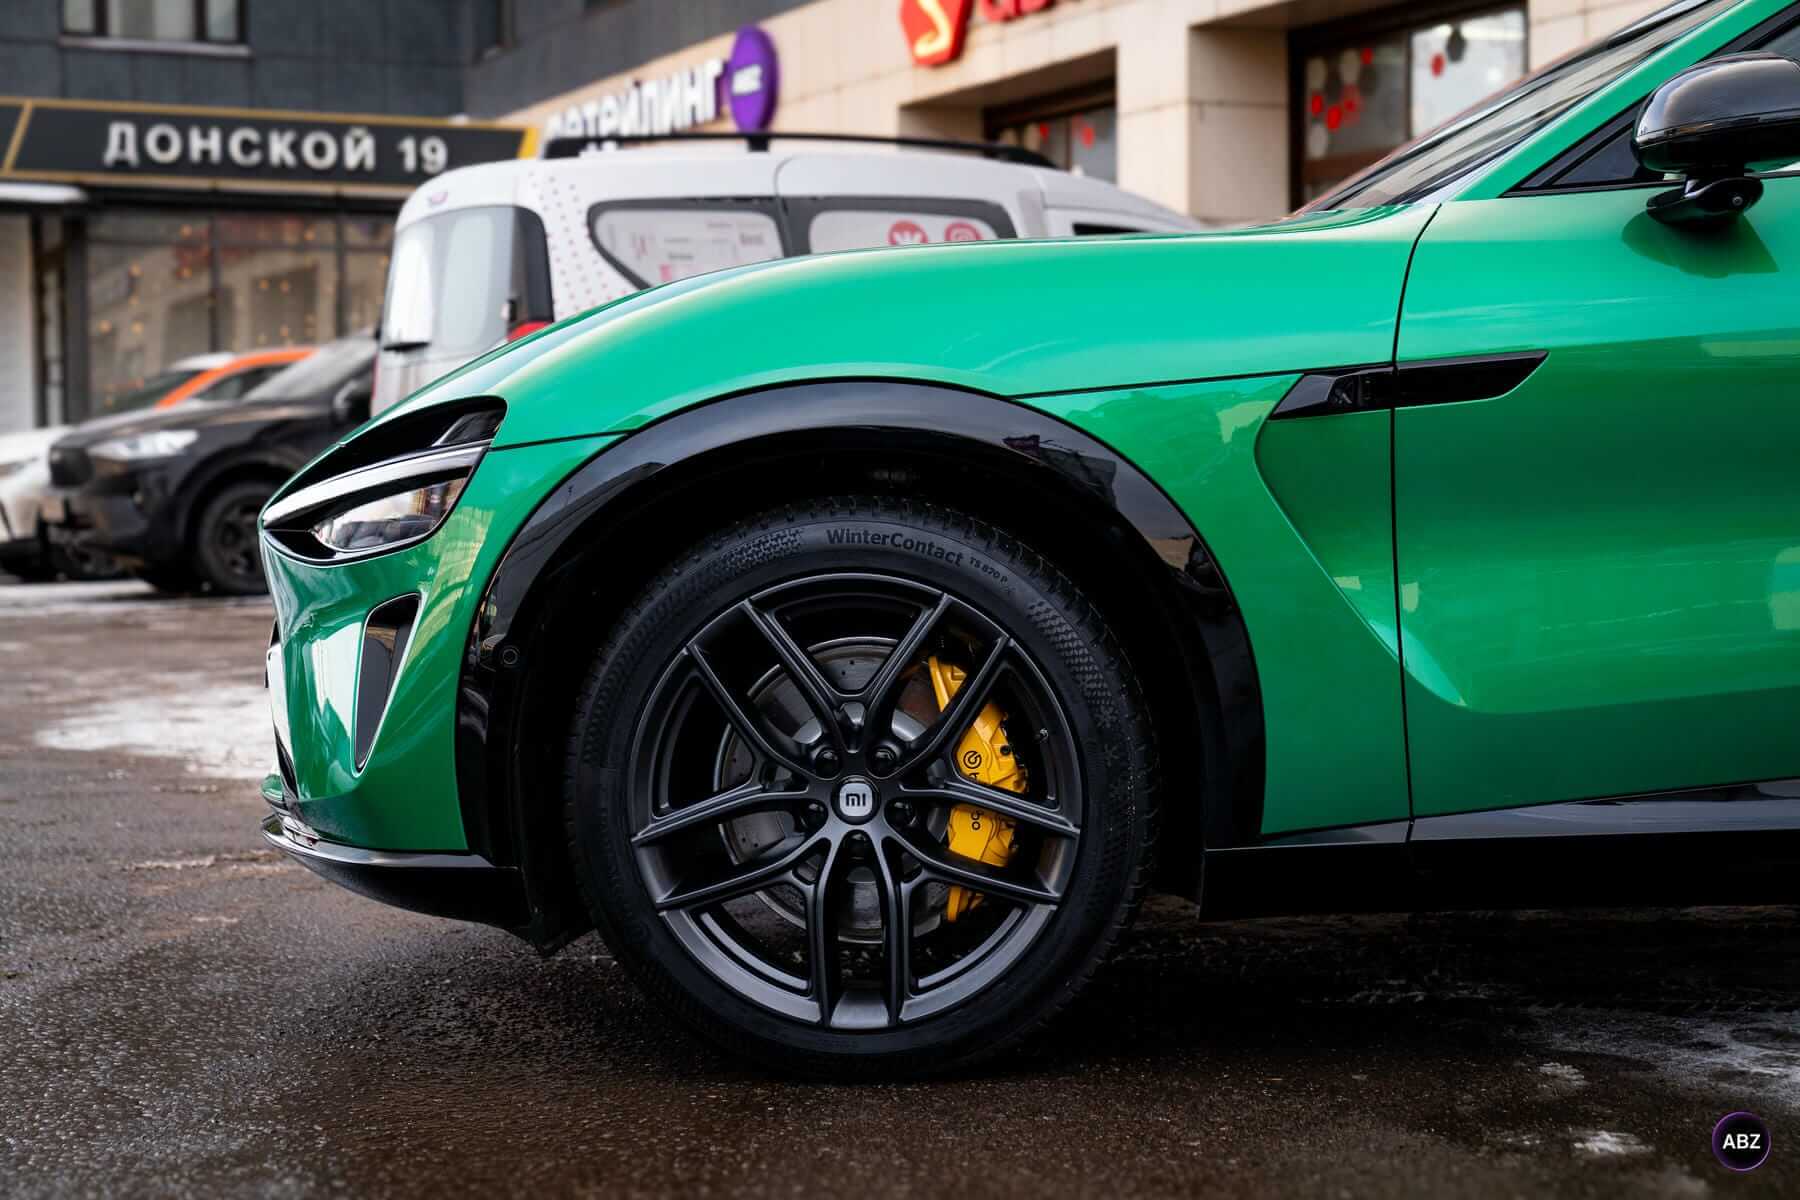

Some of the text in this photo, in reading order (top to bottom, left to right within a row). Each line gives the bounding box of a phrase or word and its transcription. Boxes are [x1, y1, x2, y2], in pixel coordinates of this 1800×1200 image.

[103, 121, 449, 174] ДОНСКОЙ 19
[826, 528, 965, 567] WinterContact
